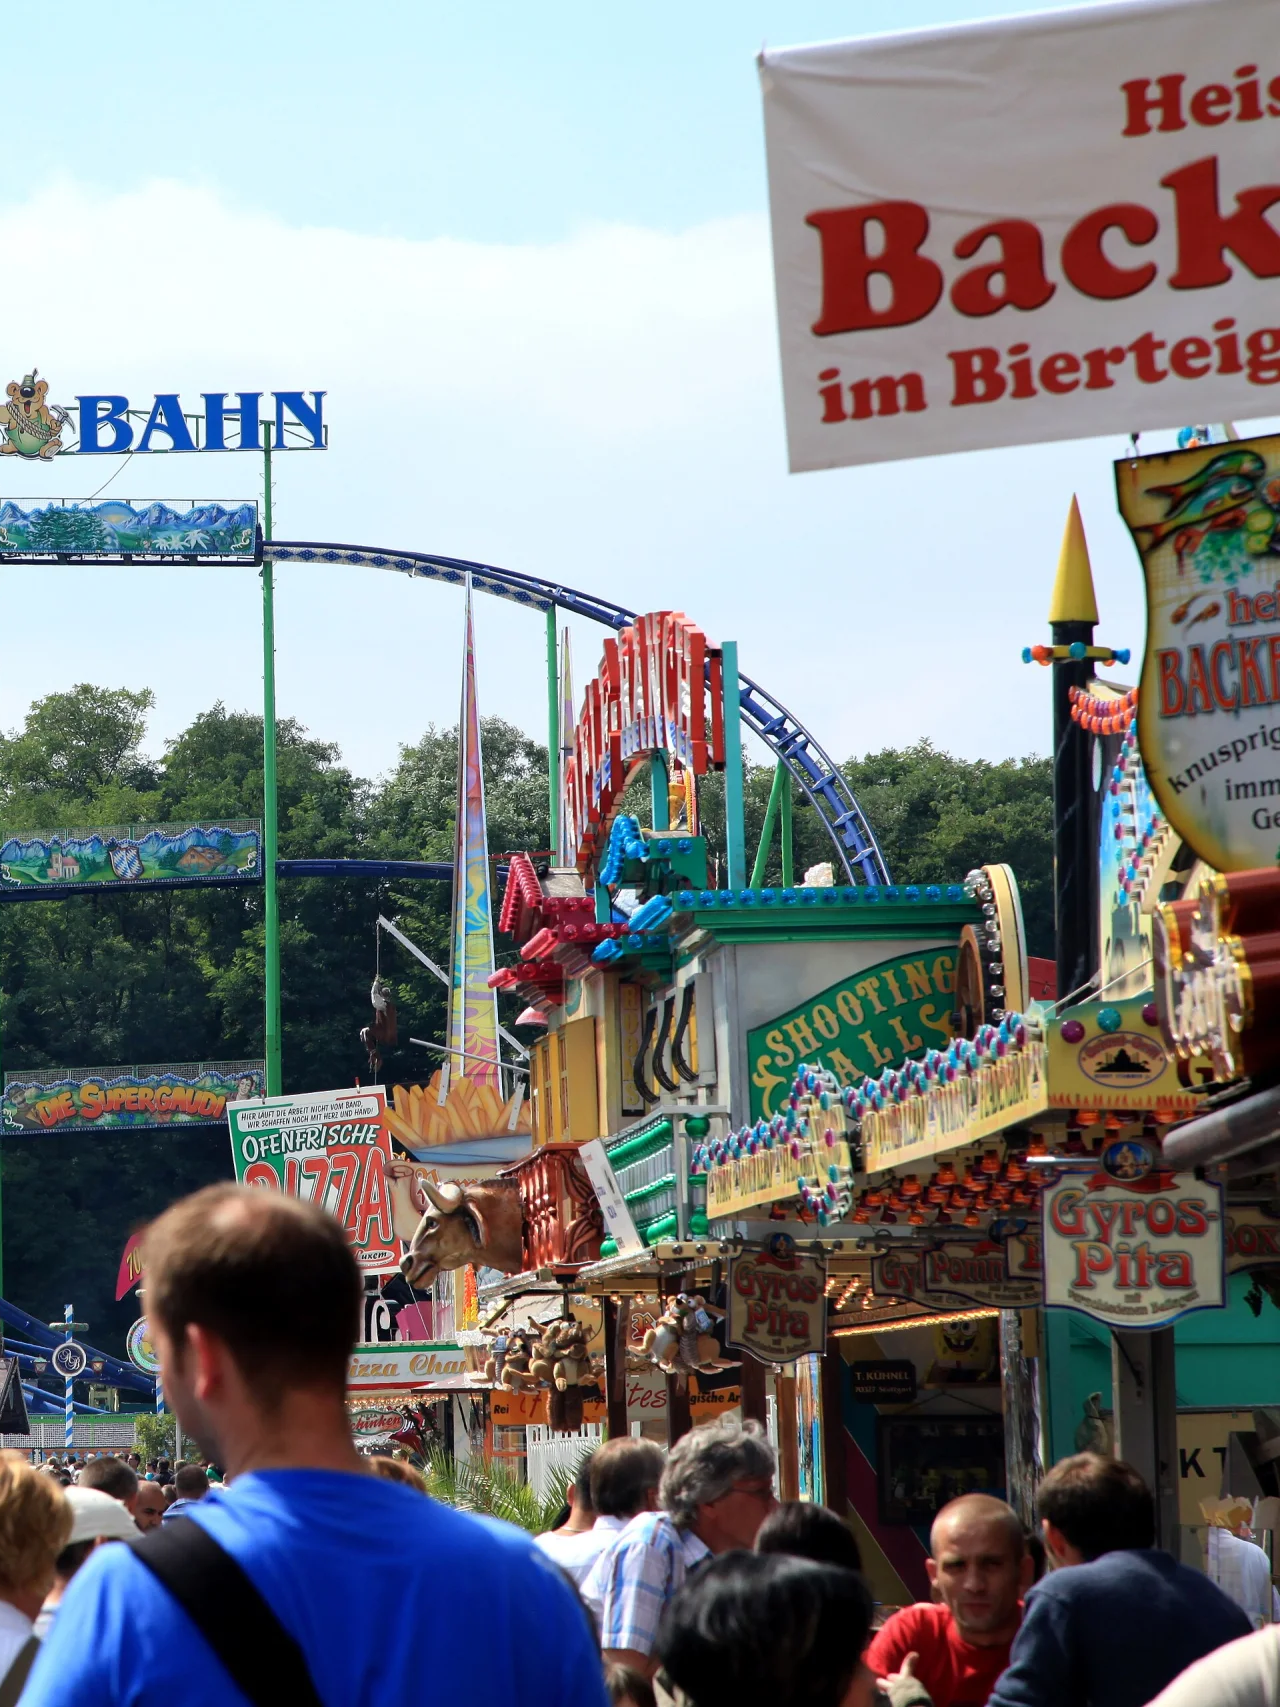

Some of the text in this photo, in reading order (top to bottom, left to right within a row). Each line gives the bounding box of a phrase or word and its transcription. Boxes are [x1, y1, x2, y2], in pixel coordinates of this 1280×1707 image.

[818, 317, 1280, 424] im Bierteig
[74, 391, 328, 454] BAHN
[765, 954, 959, 1068] SHOOTING
[795, 1015, 925, 1087] ALL
[35, 1083, 227, 1127] DIE SUPERGAUDI
[241, 1112, 257, 1120] HIER
[276, 1109, 287, 1117] DIE
[287, 1106, 309, 1116] ARBEIT
[310, 1105, 329, 1113] NICHT
[330, 1102, 344, 1110] VOM
[247, 1120, 260, 1129] WIR
[261, 1117, 291, 1128] SCHAFFEN
[292, 1115, 309, 1124] NOCH
[310, 1113, 322, 1122] MIT
[324, 1112, 339, 1120] HERZ
[340, 1110, 353, 1118] UND
[241, 1123, 381, 1164] OFENFRISCHE
[1051, 1187, 1220, 1244] Gyros-
[1071, 1240, 1196, 1290] Pita
[744, 1299, 810, 1338] Pita
[348, 1357, 401, 1378] izza
[866, 1369, 910, 1381] KÜHNEL
